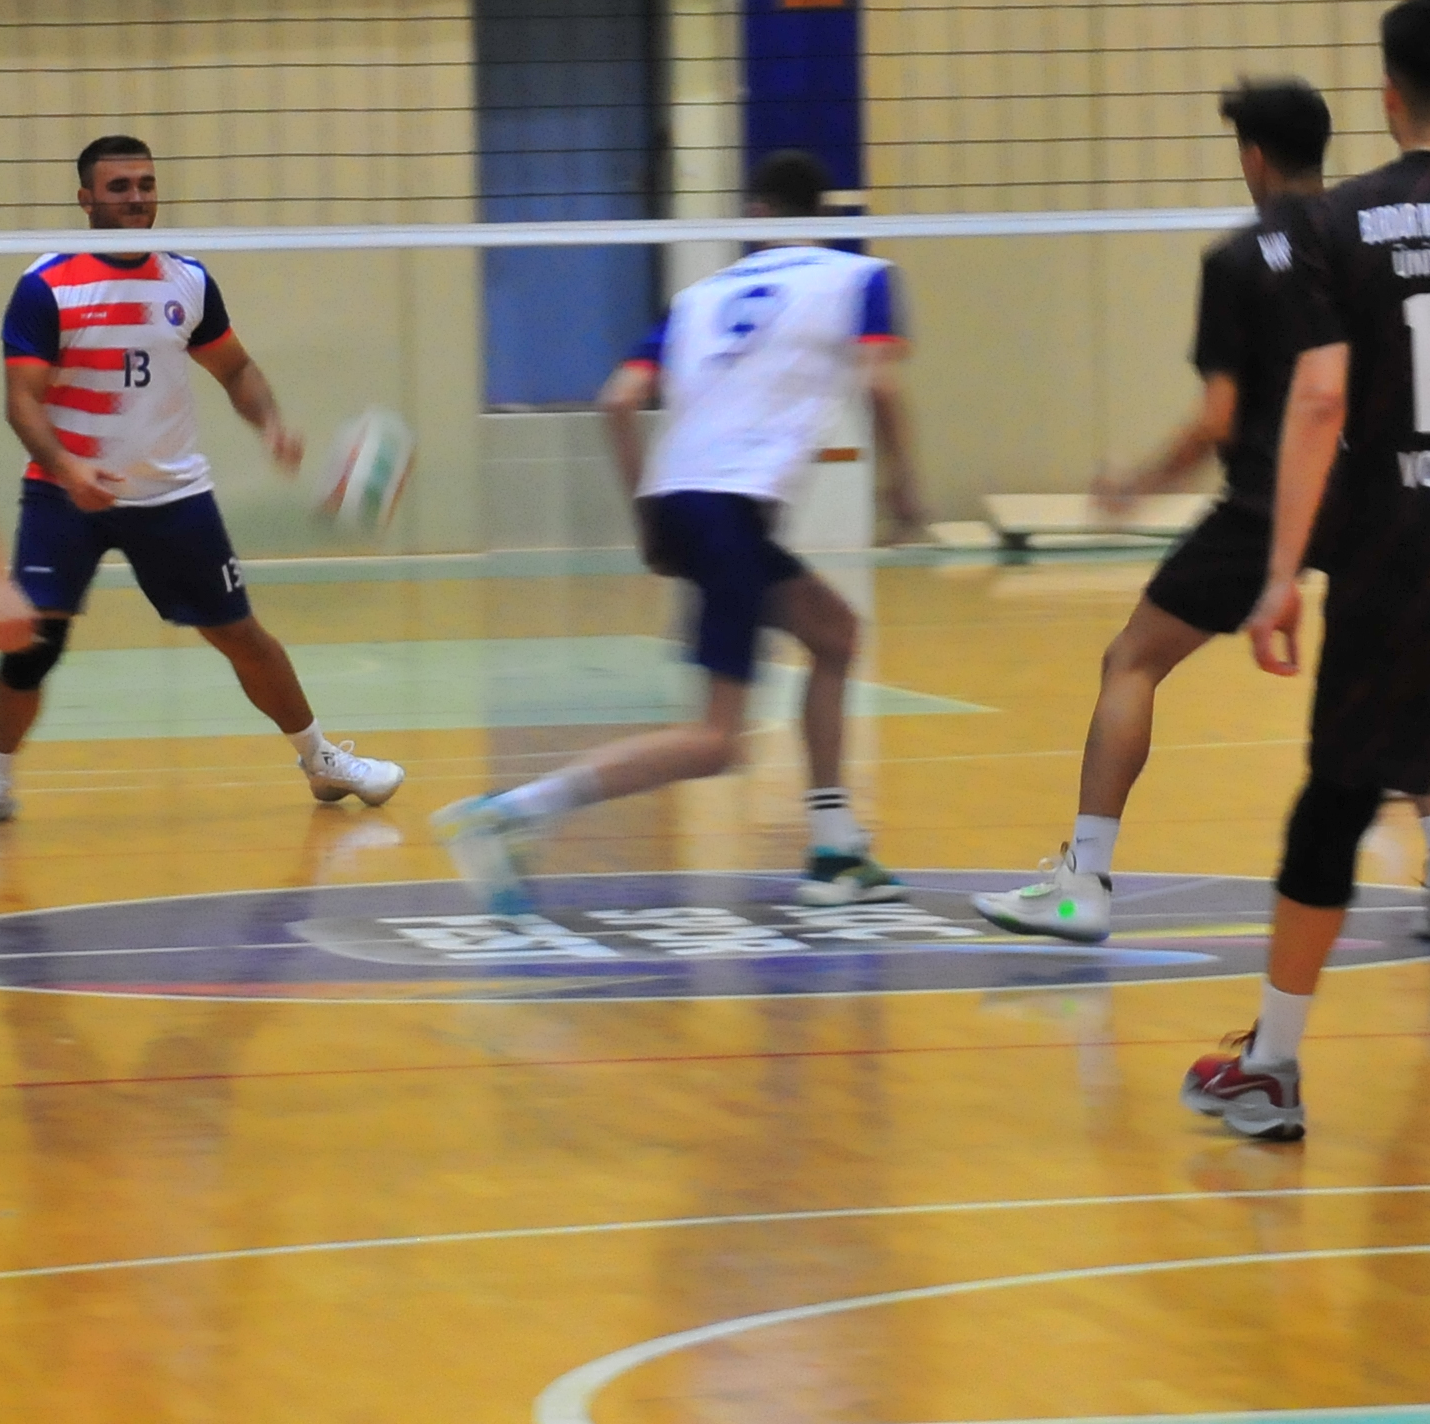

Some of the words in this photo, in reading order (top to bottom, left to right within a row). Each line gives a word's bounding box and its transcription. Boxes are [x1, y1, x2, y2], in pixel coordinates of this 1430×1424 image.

[123, 350, 151, 388] 13
[221, 556, 244, 592] 13
[377, 914, 622, 959] FEST
[585, 907, 810, 955] SPOR
[771, 903, 983, 940] KOÇ
